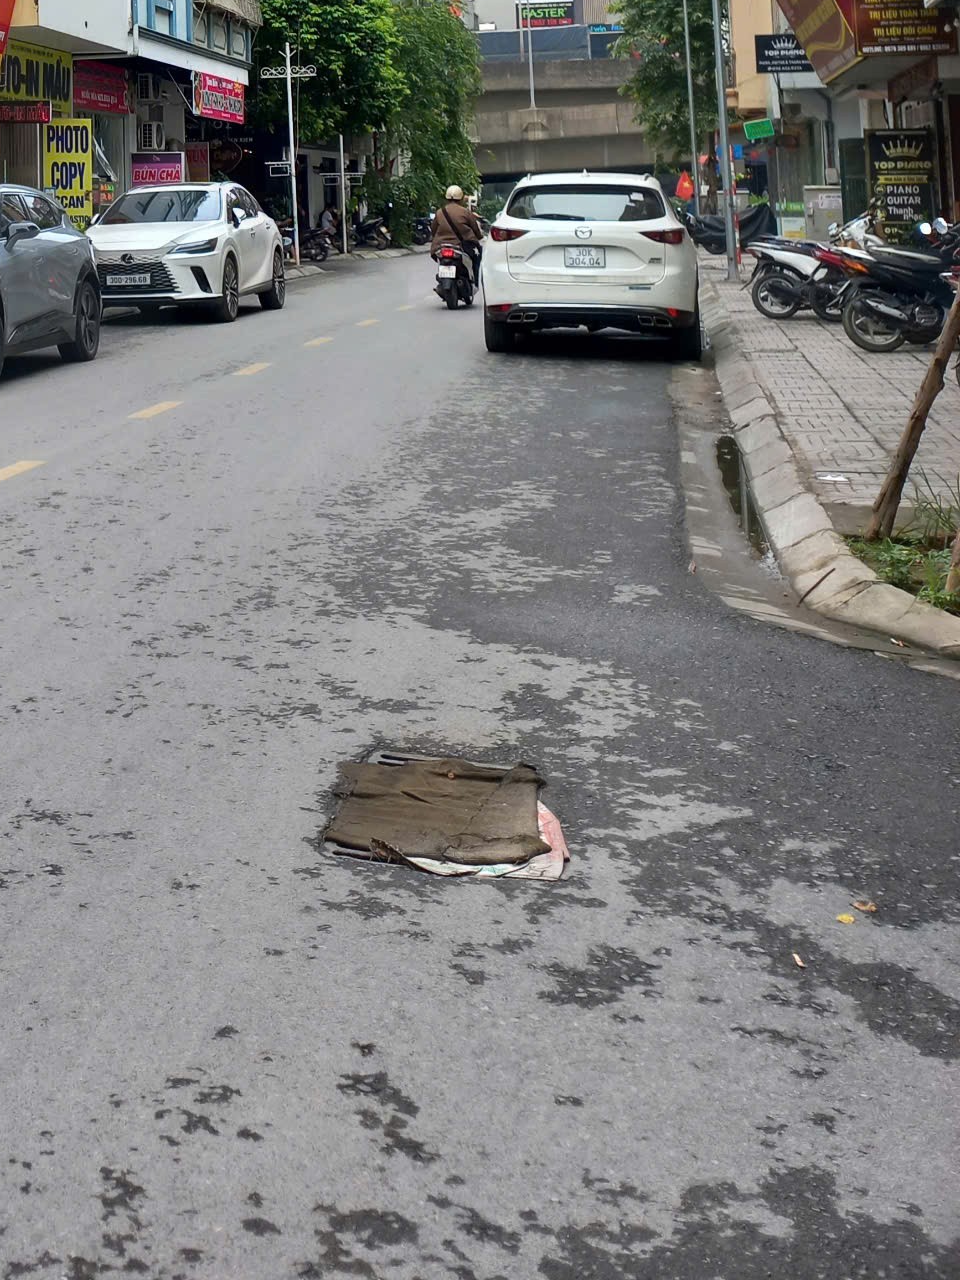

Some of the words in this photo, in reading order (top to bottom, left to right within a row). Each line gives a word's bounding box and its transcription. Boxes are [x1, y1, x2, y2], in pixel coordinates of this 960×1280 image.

[522, 7, 566, 18] FASTER
[46, 125, 89, 154] PHOTO
[874, 161, 896, 170] TOP
[896, 160, 932, 169] PIANO
[51, 161, 86, 190] COPY
[133, 165, 158, 183] BÚN
[158, 163, 181, 181] CHẢ
[886, 185, 920, 194] PIANO
[886, 196, 921, 205] GUITAR
[887, 206, 913, 215] Thanh
[575, 248, 593, 257] 30K
[568, 257, 601, 266] 304.04
